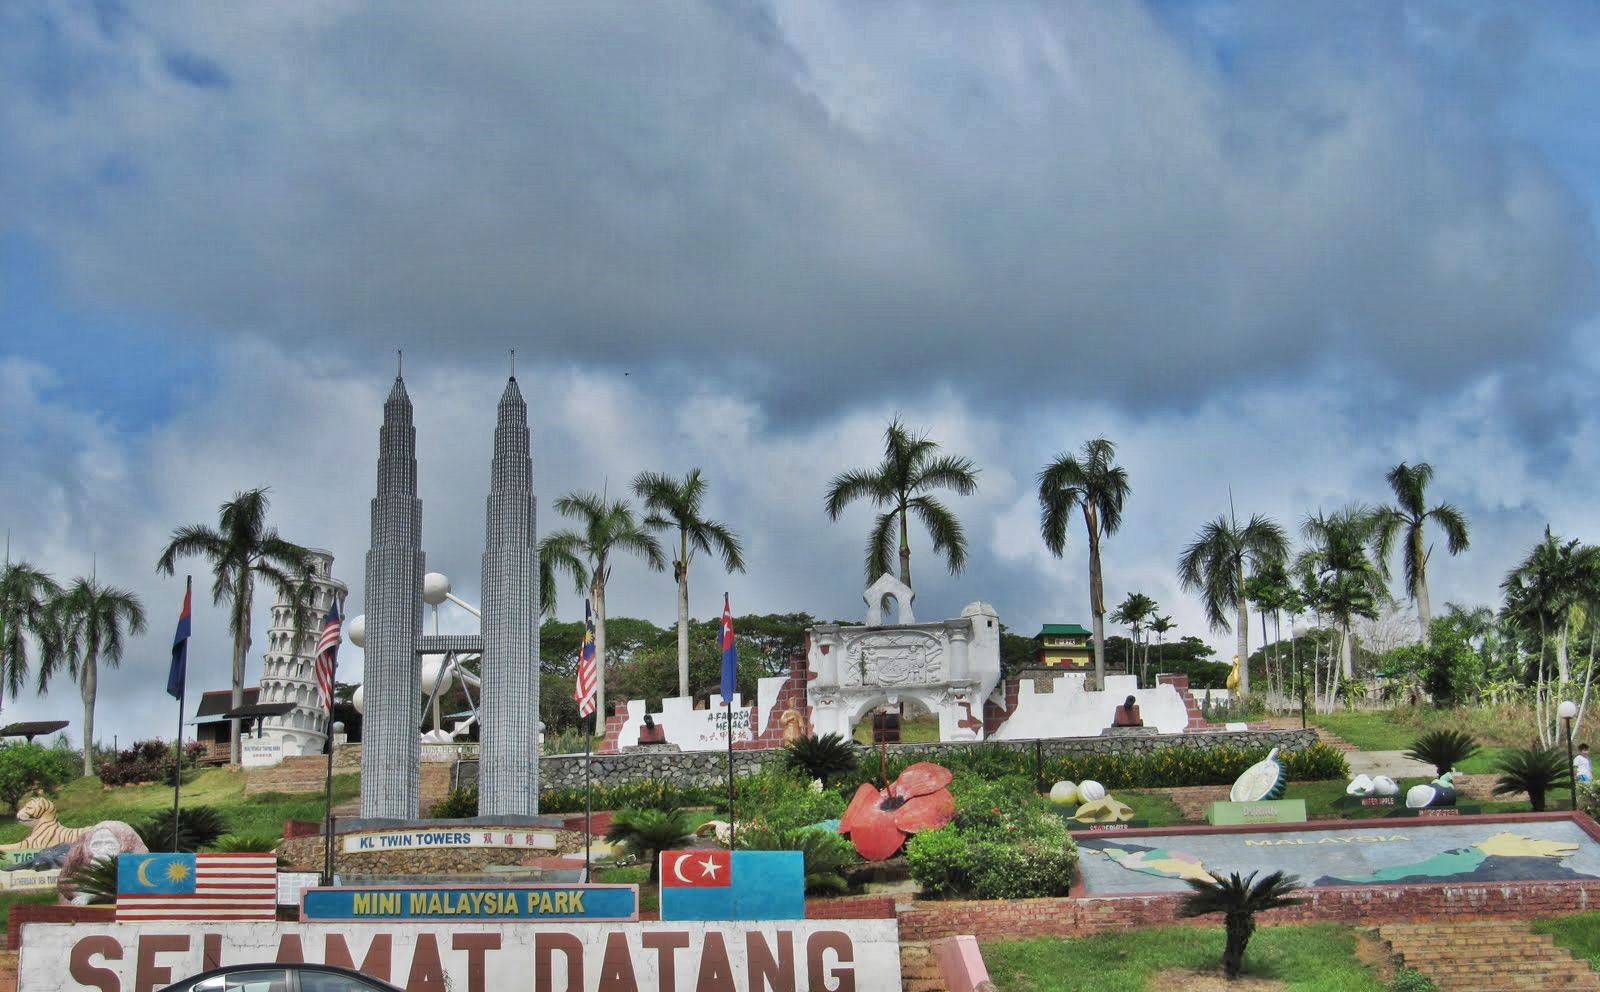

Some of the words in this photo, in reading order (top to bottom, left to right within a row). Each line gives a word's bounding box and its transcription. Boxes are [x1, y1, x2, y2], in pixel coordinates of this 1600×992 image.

[716, 720, 749, 730] MEAKA
[360, 837, 374, 848] KL
[380, 835, 412, 846] TWIN
[416, 833, 471, 845] TOWERS
[1245, 835, 1410, 846] MALAYSIA
[353, 892, 401, 915] MINI
[410, 891, 519, 914] MALAYSIA
[527, 890, 584, 913] PARK
[535, 930, 855, 992] DATANG
